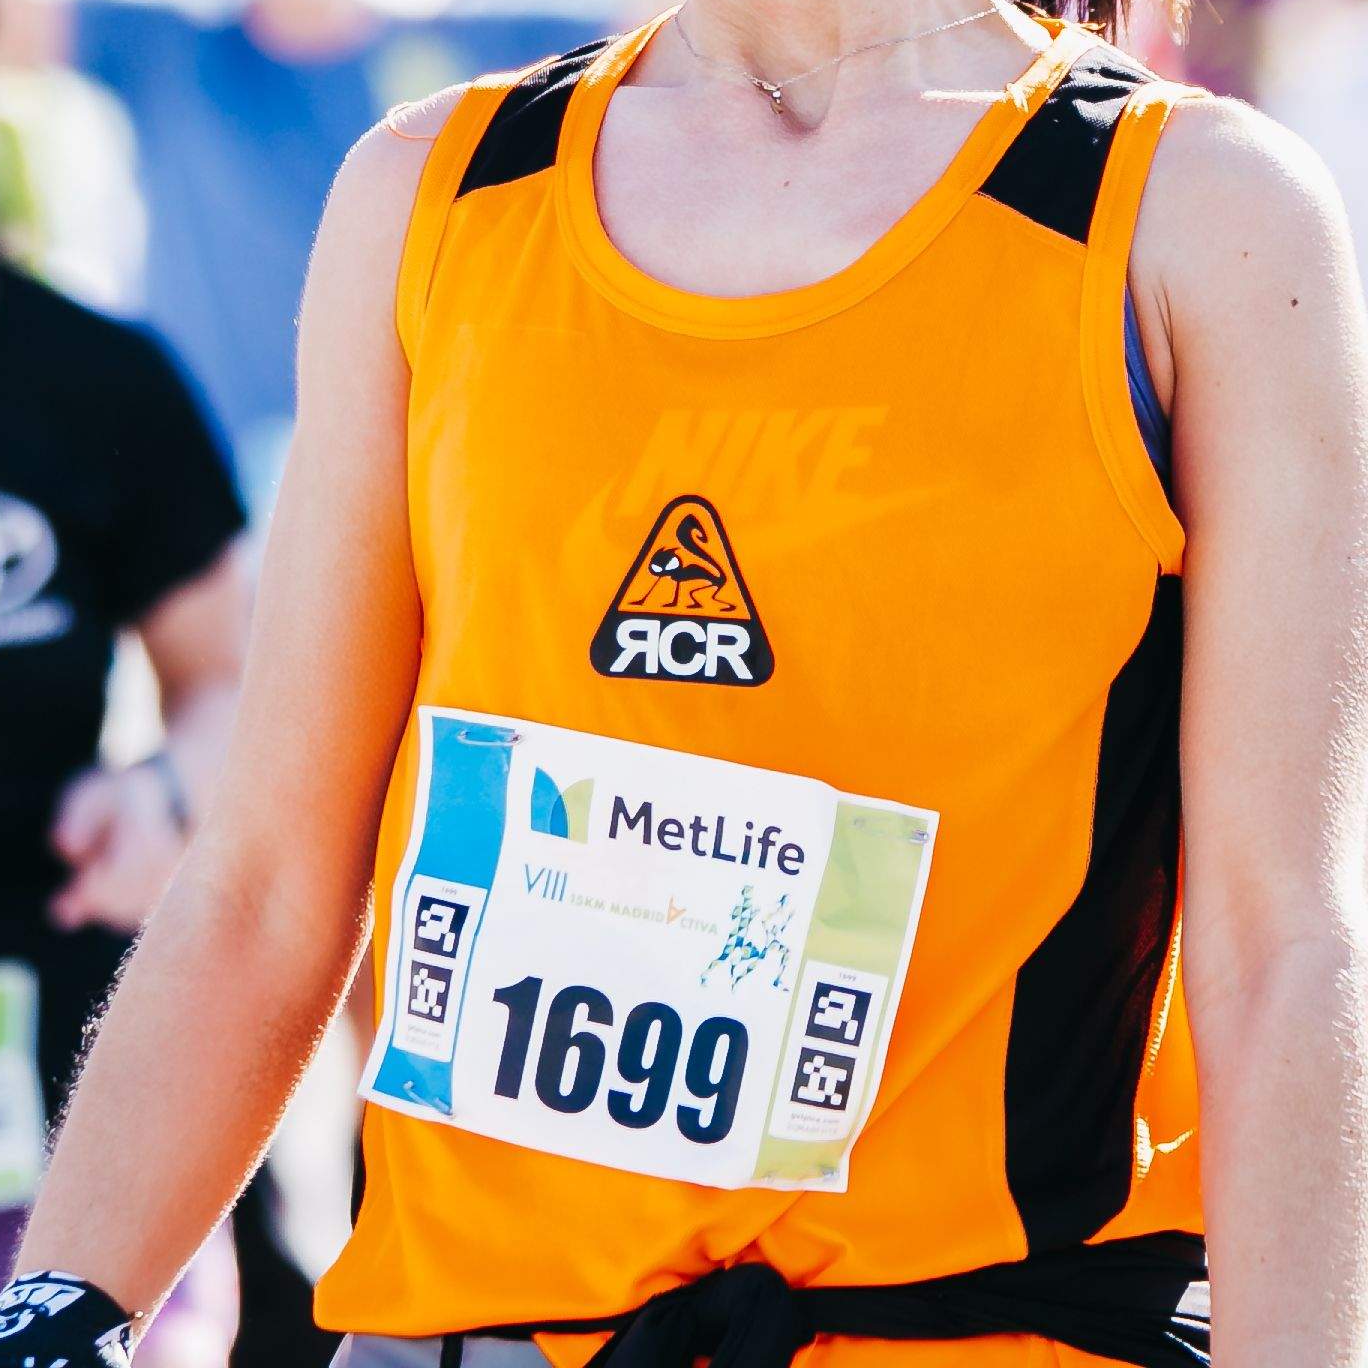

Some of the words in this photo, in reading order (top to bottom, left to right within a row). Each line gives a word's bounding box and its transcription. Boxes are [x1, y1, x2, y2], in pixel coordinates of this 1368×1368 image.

[614, 404, 890, 518] NIKE
[608, 794, 806, 876] MetLife
[523, 862, 569, 903] VIII
[569, 892, 607, 913] 15KM
[610, 903, 665, 924] MADRID
[492, 975, 750, 1145] 1699
